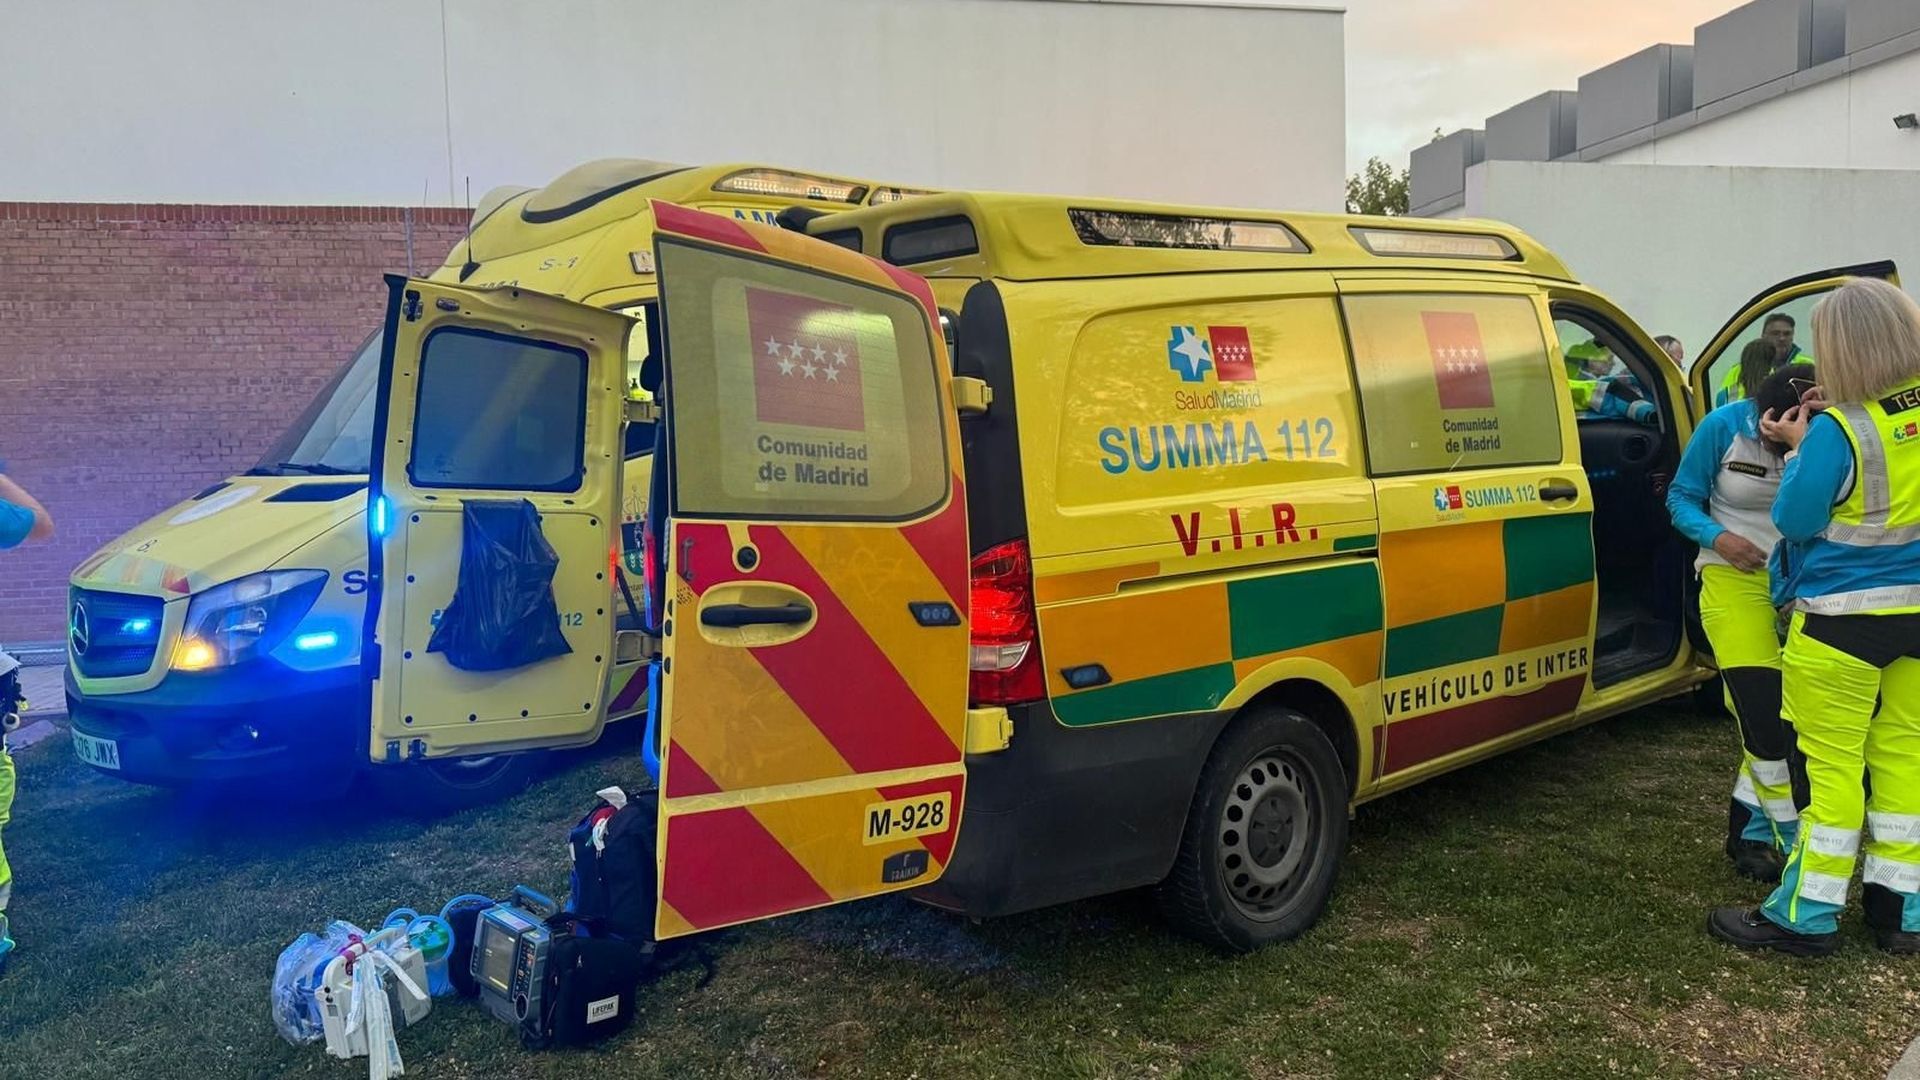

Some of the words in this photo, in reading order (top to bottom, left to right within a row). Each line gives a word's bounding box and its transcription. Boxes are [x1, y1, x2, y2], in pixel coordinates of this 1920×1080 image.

[1175, 389, 1262, 410] SaludMadrid
[1443, 417, 1498, 433] Comunidad
[757, 435, 867, 461] Comunidad
[1099, 420, 1268, 475] SUMMA
[1277, 416, 1337, 459] 112
[1446, 438, 1460, 453] de
[1463, 434, 1501, 451] Madrid
[759, 461, 786, 482] de
[795, 463, 868, 487] Madrid
[1465, 487, 1515, 508] SUMMA
[1515, 484, 1536, 502] 112
[1171, 502, 1319, 557] V.I.R.
[343, 570, 367, 594] S
[1384, 669, 1493, 716] VEHÍCULO
[1505, 662, 1527, 687] DE
[1536, 647, 1588, 678] INTER
[95, 741, 116, 765] JWX
[869, 800, 944, 838] M-928
